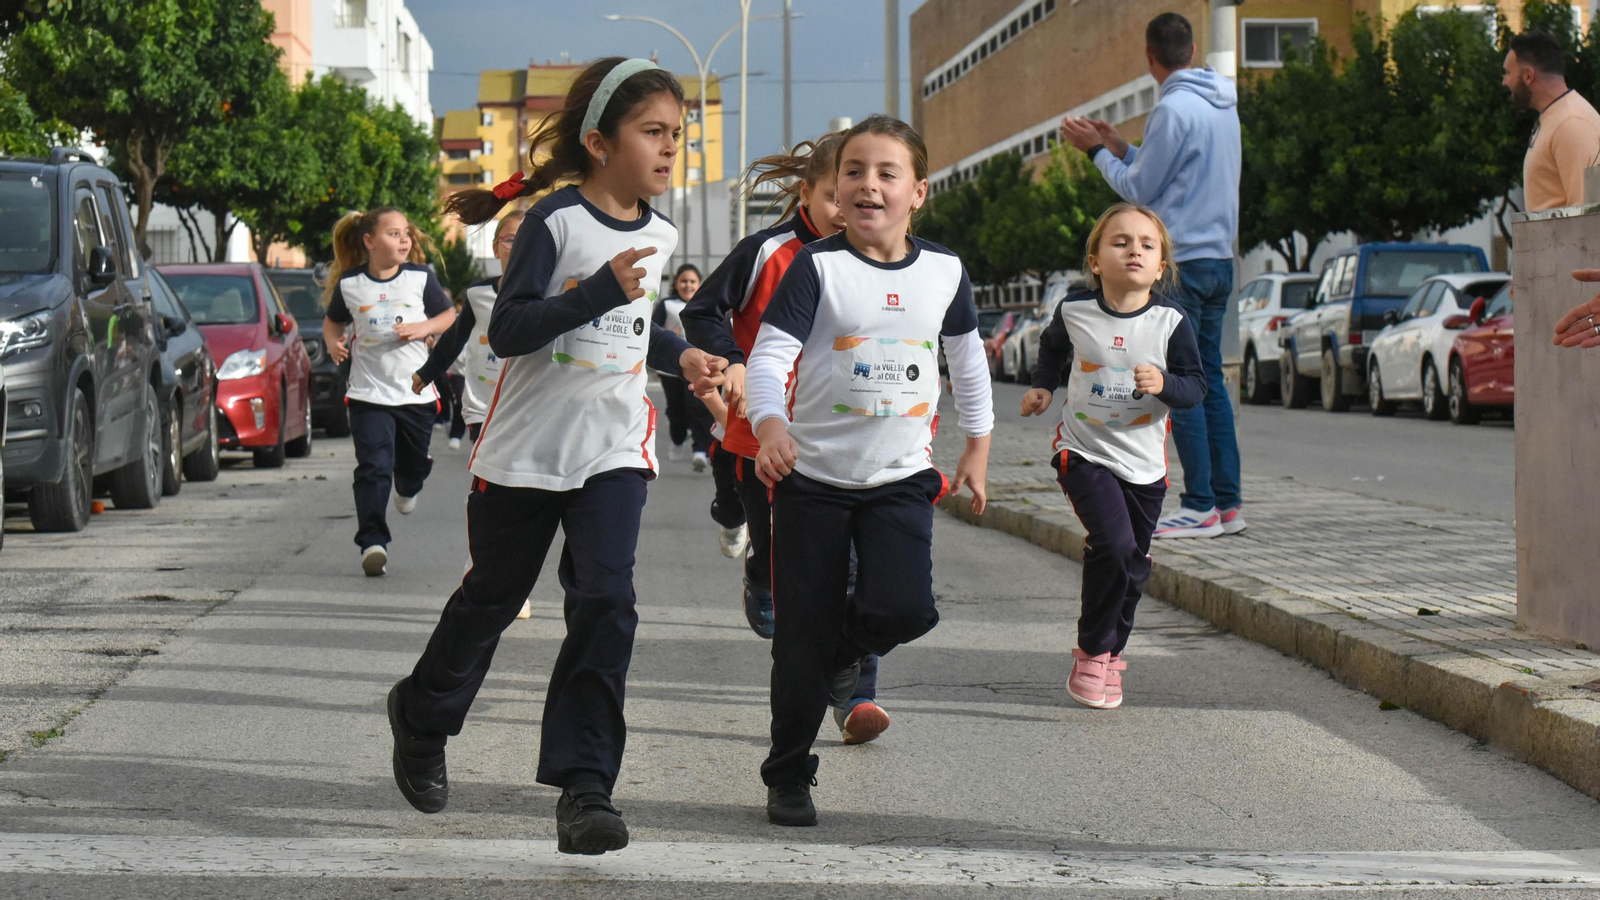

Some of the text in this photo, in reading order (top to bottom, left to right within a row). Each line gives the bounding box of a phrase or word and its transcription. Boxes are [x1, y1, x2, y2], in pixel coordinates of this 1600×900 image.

[611, 315, 632, 324] VUELTA
[612, 324, 628, 334] COLE
[882, 364, 905, 372] VUELTA
[885, 373, 900, 381] COLE
